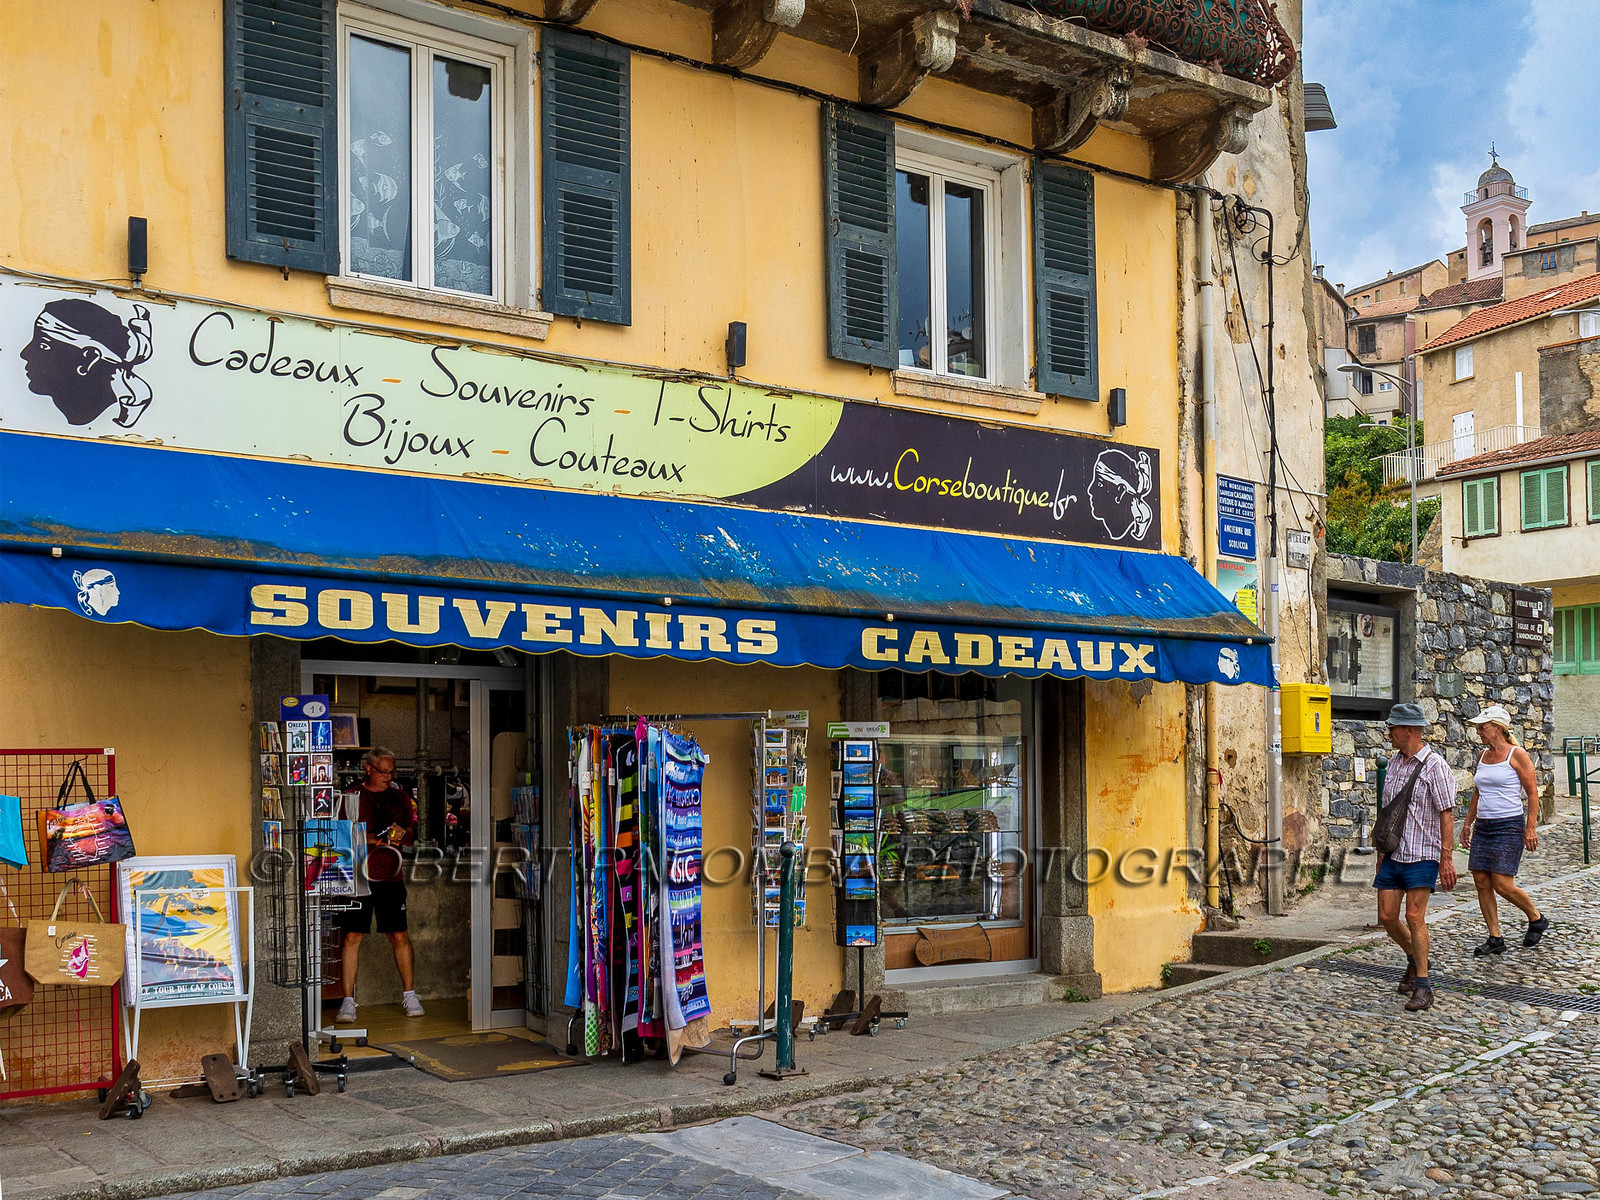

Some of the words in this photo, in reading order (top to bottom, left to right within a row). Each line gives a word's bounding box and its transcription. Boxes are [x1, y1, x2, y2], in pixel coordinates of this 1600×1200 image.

[188, 311, 364, 387] Cadeaux
[420, 345, 595, 417] Souvenirs
[343, 393, 476, 465] Bijoux
[529, 416, 687, 484] Couteaux
[830, 448, 1078, 521] www.Corseboutique.fr
[1224, 524, 1244, 536] ANCIENNE
[1244, 528, 1252, 537] RUE
[1218, 562, 1246, 572] ALTIPIANI
[250, 583, 778, 656] SOUVENIRS
[861, 626, 1156, 674] CADEAUX
[310, 706, 315, 714] 1
[153, 986, 175, 994] TOUR
[176, 984, 188, 993] DU
[190, 984, 206, 992] CAP
[208, 982, 234, 990] CORSE
